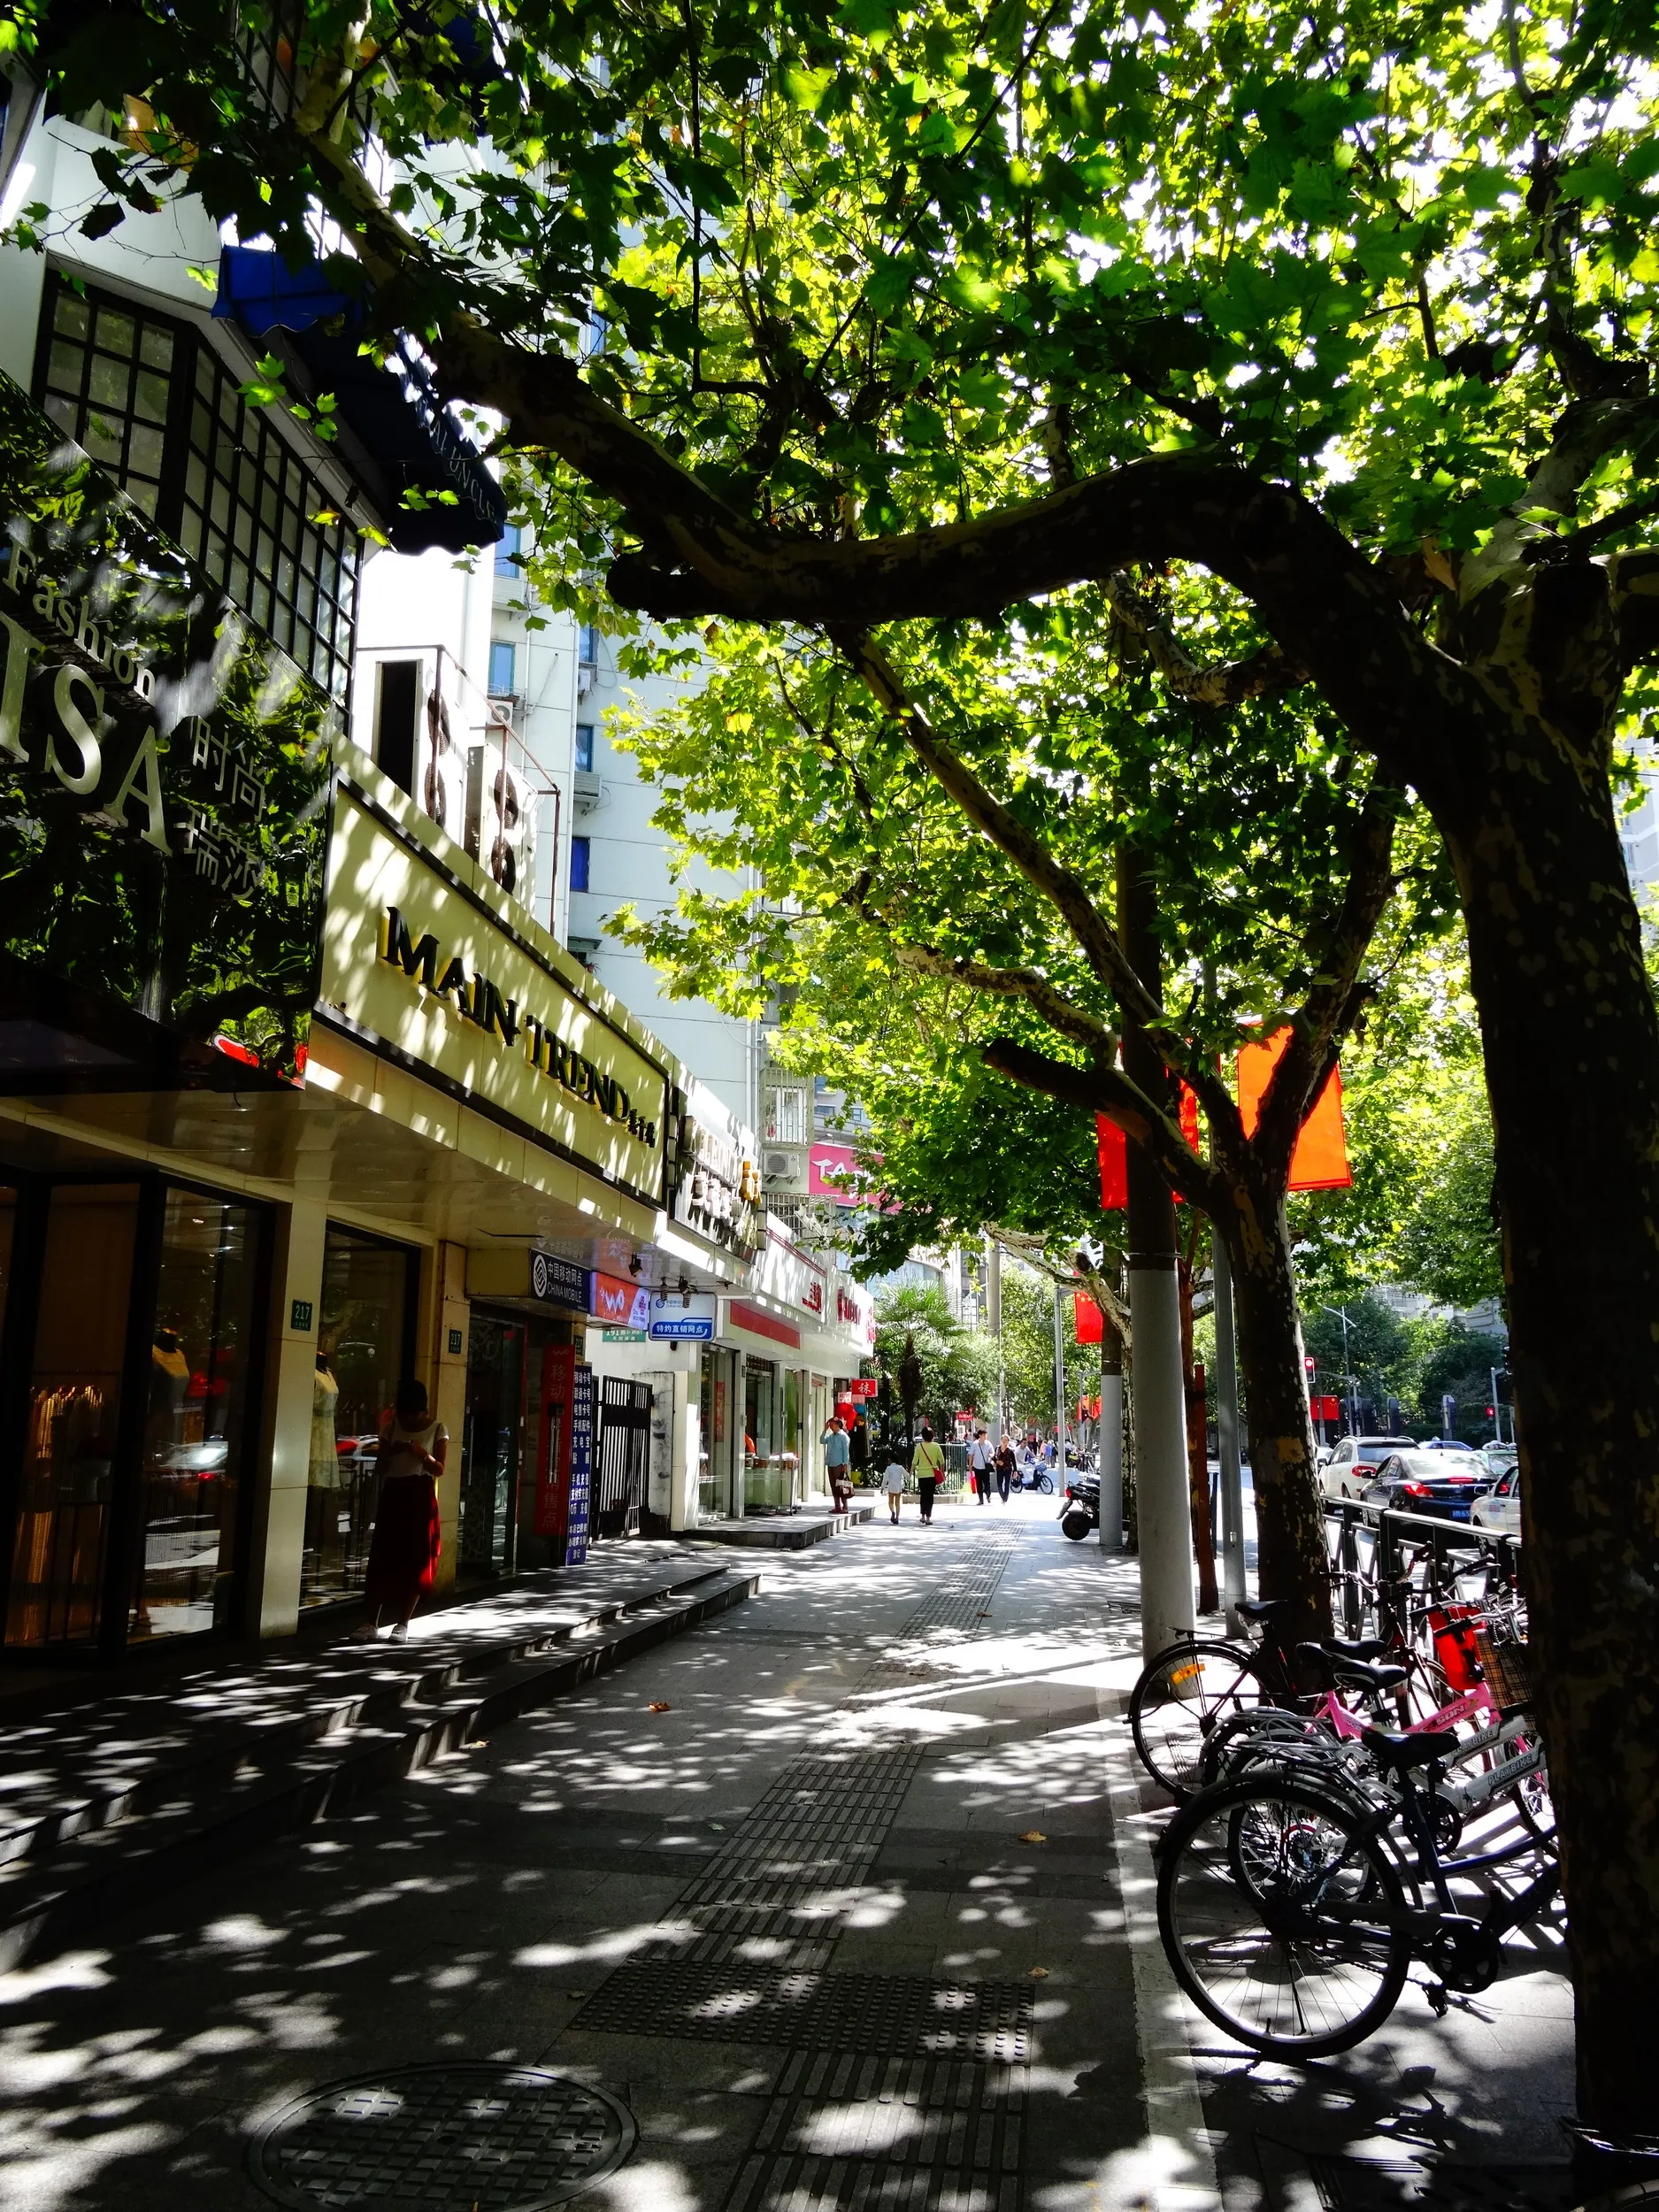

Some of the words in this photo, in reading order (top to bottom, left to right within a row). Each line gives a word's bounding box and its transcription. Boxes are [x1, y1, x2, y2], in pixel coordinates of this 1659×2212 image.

[3, 536, 156, 707] Fashion
[191, 714, 266, 822] 时尚
[381, 906, 519, 1047] MAIN
[526, 1014, 631, 1123] TREND
[547, 1263, 583, 1287] 中国移动网点
[547, 1283, 563, 1299] CHINA
[563, 1287, 582, 1303] MOBILE
[295, 1304, 310, 1320] 217
[450, 1333, 461, 1346] 217
[656, 1324, 703, 1333] 特约直销网点
[1487, 1754, 1532, 1786] PLAYBIKE
